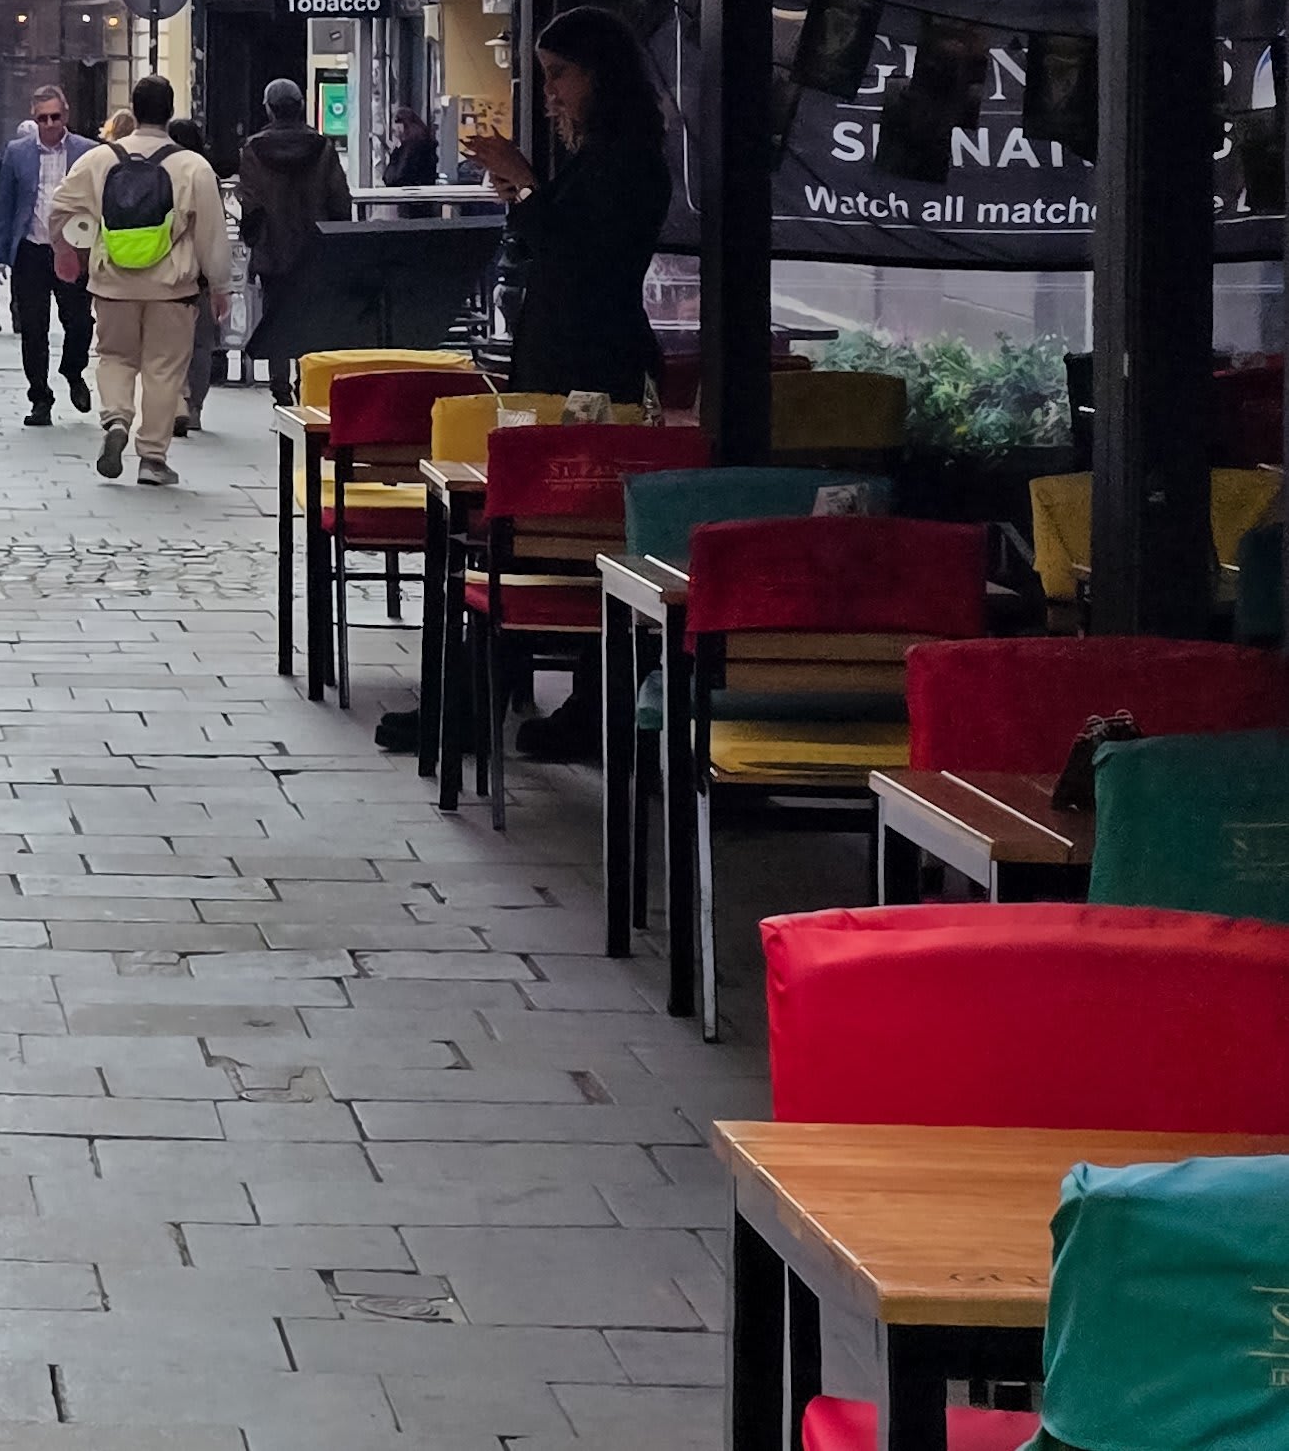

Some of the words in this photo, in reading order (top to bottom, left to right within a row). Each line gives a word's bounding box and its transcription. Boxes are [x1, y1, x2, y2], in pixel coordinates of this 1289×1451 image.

[804, 184, 909, 219] Watch
[921, 195, 964, 223] all
[977, 196, 1097, 224] match
